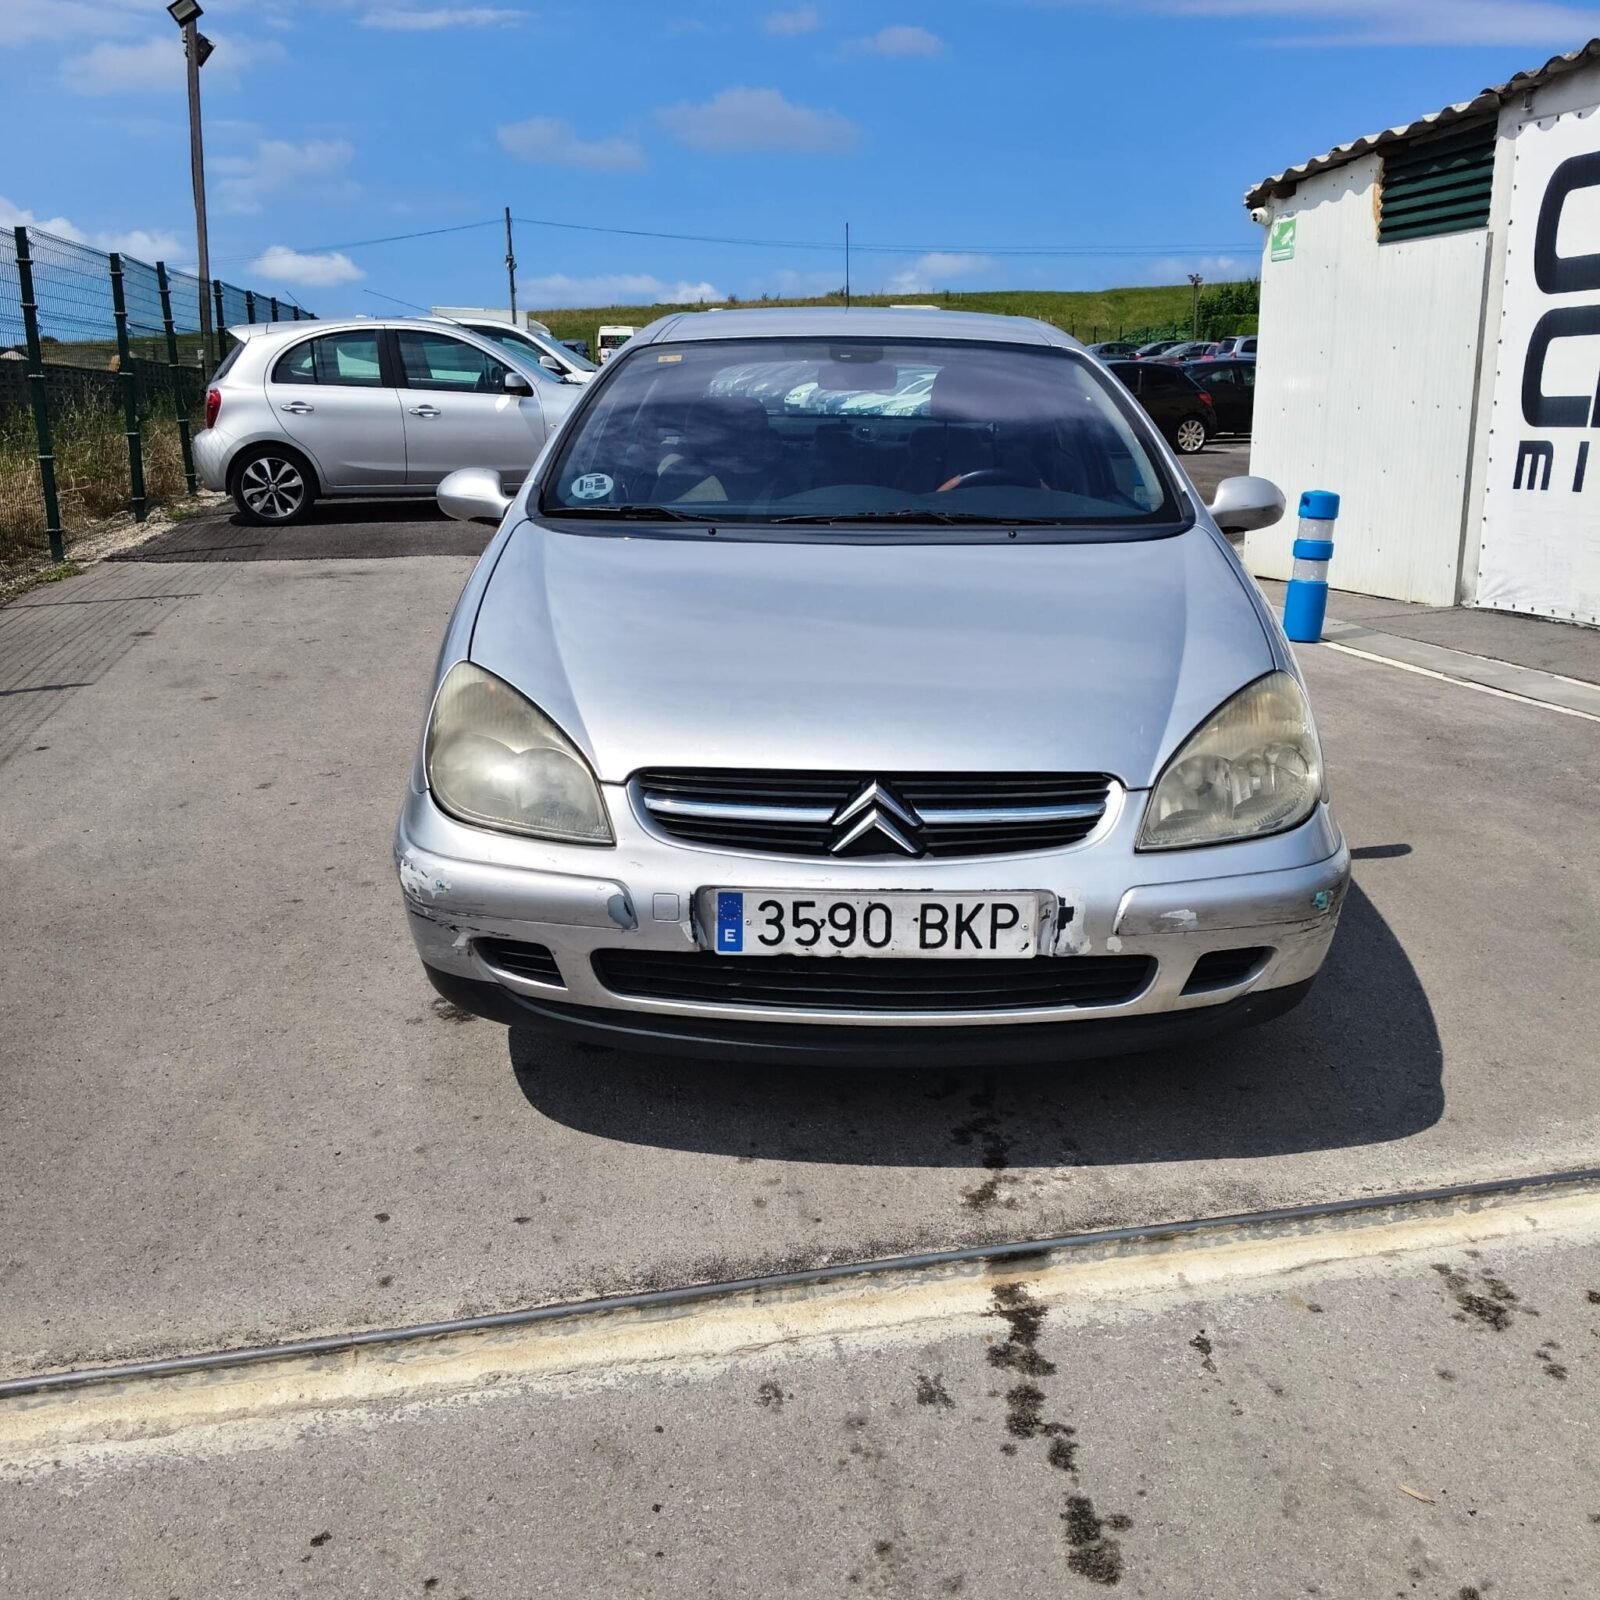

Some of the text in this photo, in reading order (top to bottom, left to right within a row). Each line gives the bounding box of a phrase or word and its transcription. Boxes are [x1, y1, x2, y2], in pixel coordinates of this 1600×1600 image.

[724, 899, 1020, 950] E 3590 BKP
